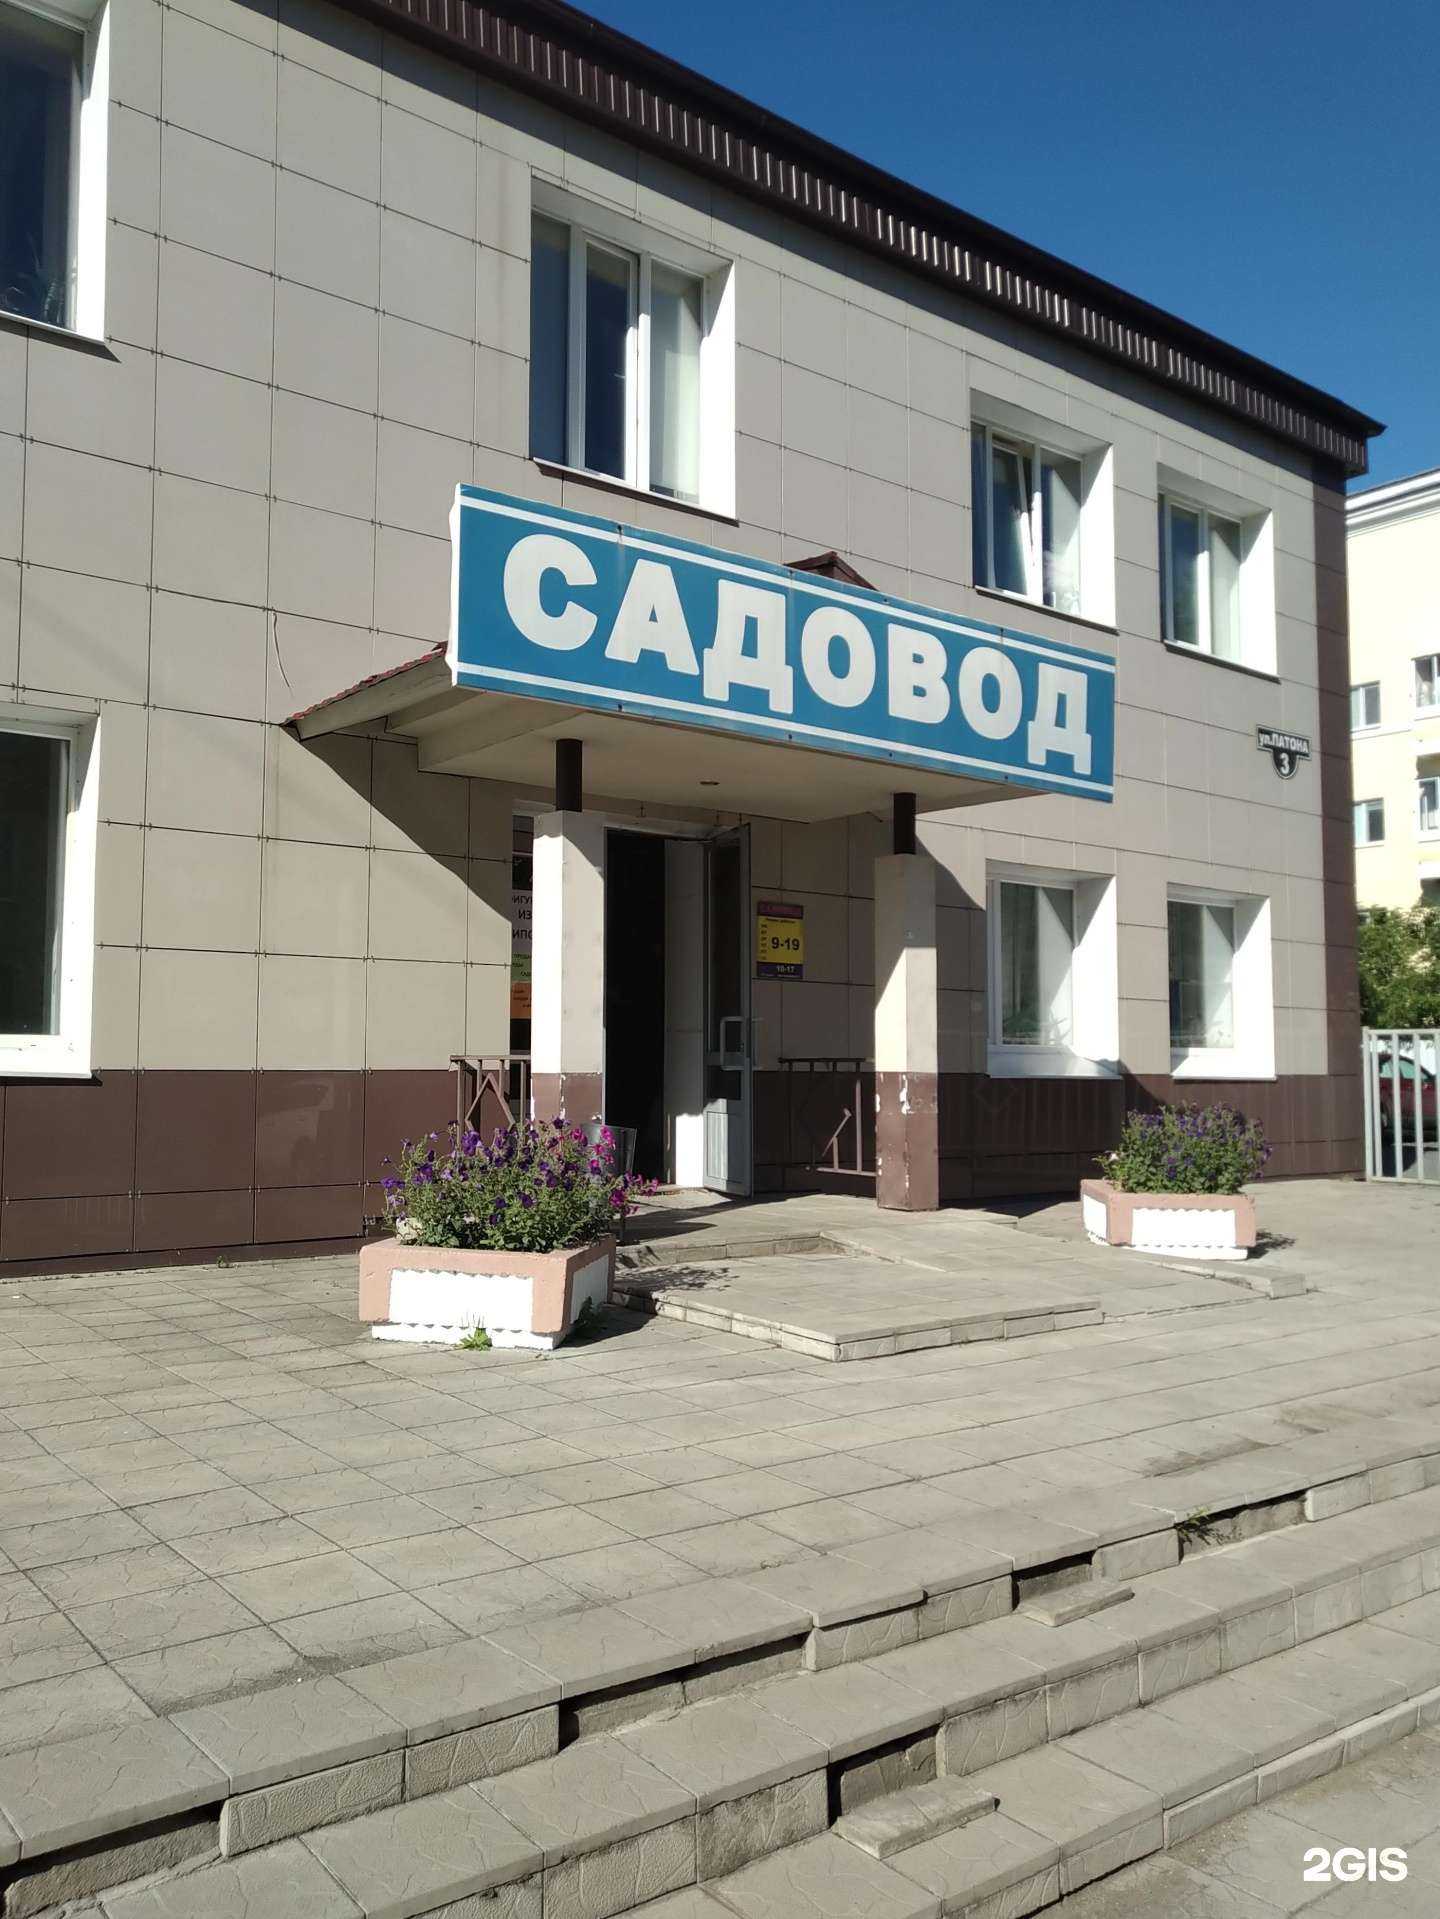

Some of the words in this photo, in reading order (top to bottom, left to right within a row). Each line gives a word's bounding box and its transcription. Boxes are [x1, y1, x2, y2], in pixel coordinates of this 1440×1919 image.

[503, 533, 1092, 775] САДОВОД
[1280, 752, 1290, 774] 3
[771, 936, 800, 951] 9-19
